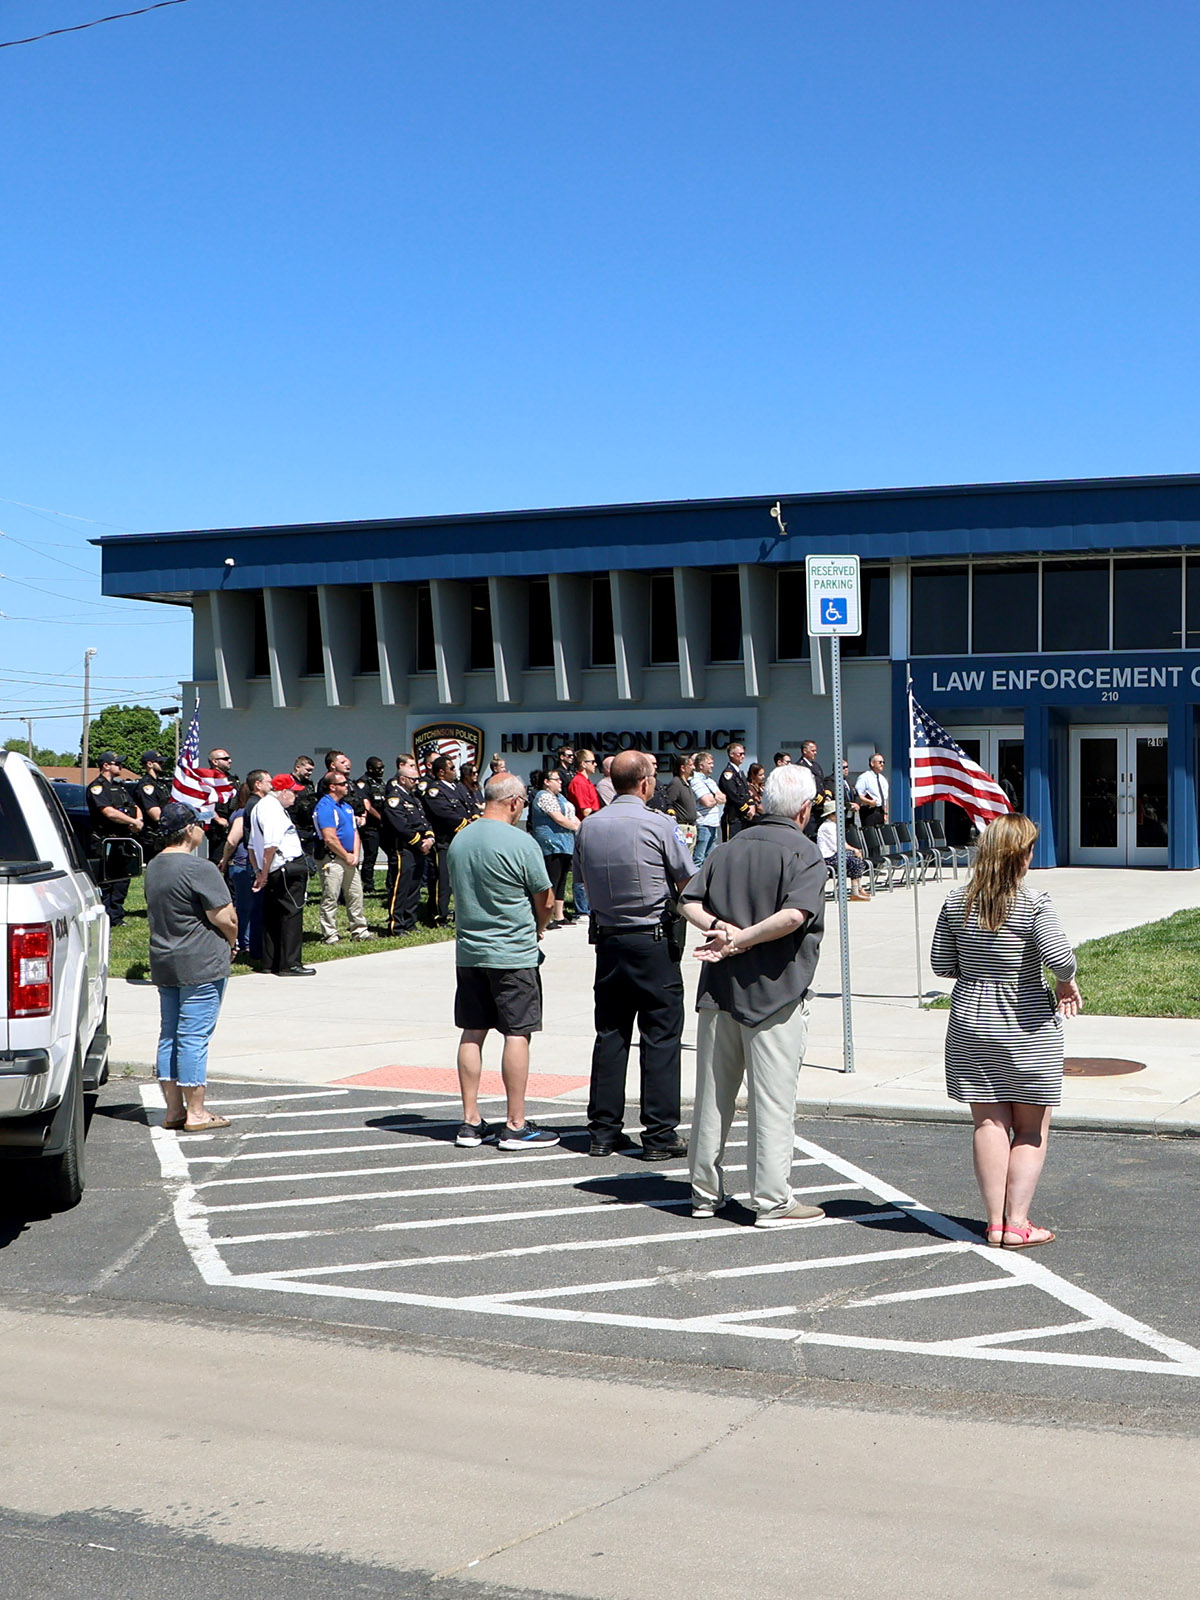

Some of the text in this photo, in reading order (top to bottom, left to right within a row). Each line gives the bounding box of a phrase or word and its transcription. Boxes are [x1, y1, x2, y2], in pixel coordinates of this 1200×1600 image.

[811, 566, 855, 576] RESERVED
[814, 580, 853, 590] PARKING
[932, 671, 985, 692] LAW
[992, 667, 1183, 691] ENFORCEMENT
[1101, 691, 1119, 702] 210
[415, 728, 478, 745] HUTCHINSON POLICE
[501, 729, 746, 753] HUTCHINSON POLICE
[1147, 737, 1164, 747] 210
